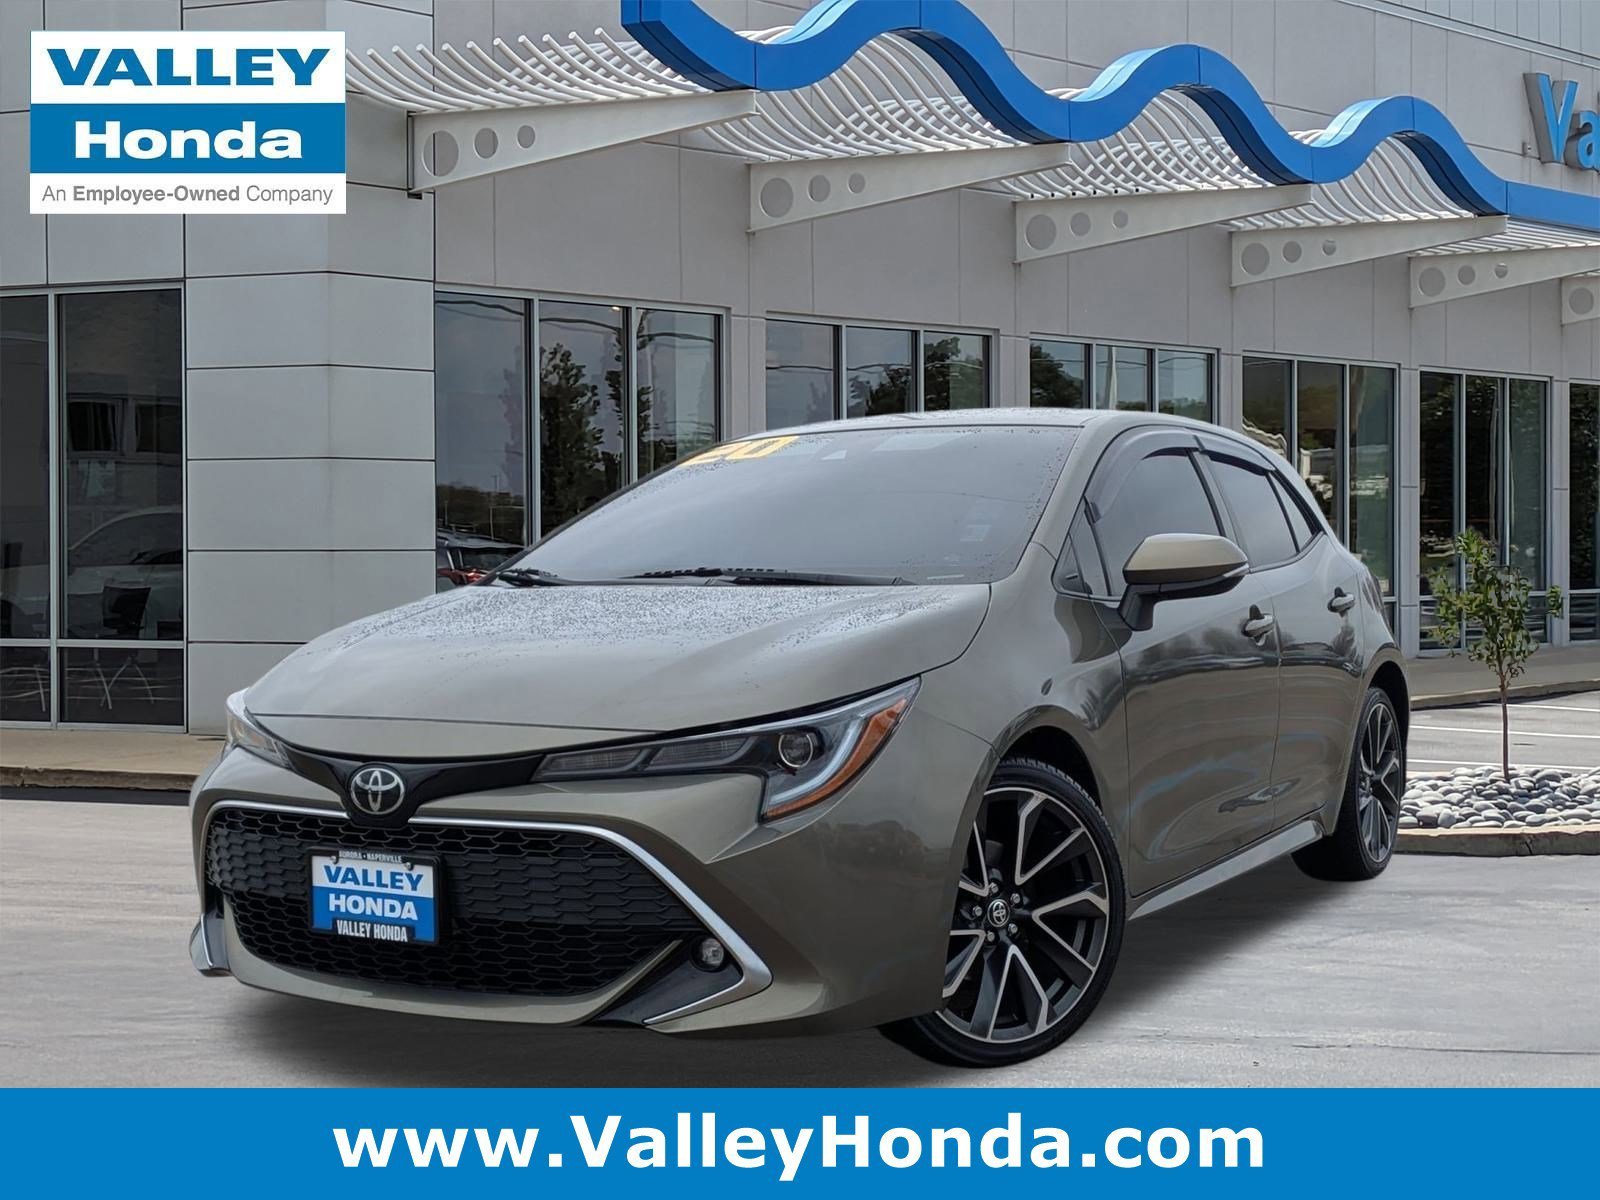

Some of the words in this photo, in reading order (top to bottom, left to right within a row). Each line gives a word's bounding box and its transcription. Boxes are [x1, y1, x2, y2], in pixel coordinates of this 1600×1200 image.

[1523, 72, 1600, 174] Va
[324, 865, 424, 892] VALLEY
[328, 893, 418, 920] HONDA
[336, 919, 372, 938] VALLEY
[373, 923, 408, 942] HONDA
